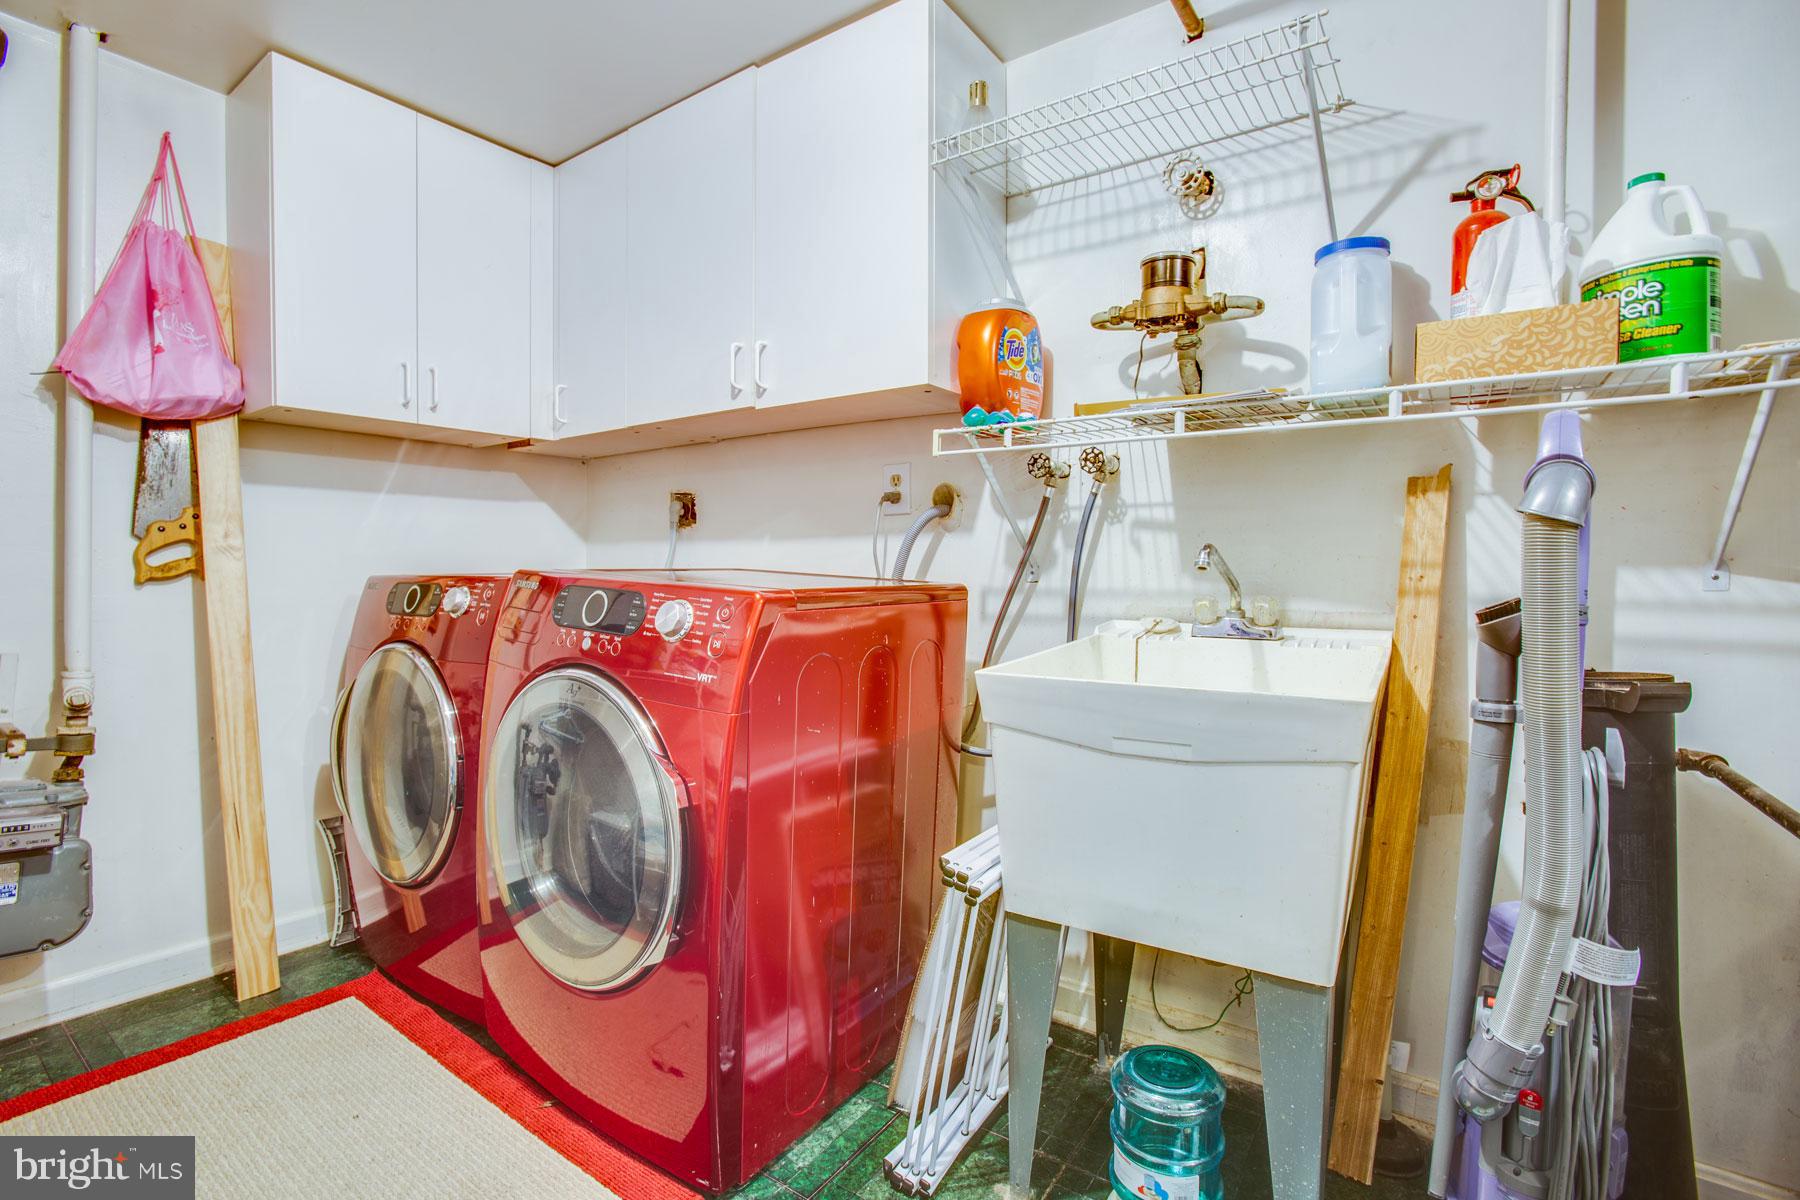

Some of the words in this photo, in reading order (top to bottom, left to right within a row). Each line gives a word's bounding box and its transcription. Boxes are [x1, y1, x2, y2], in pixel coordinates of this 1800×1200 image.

[1596, 279, 1664, 307] imple
[1633, 323, 1682, 340] Cleaner
[1006, 340, 1025, 360] Tide
